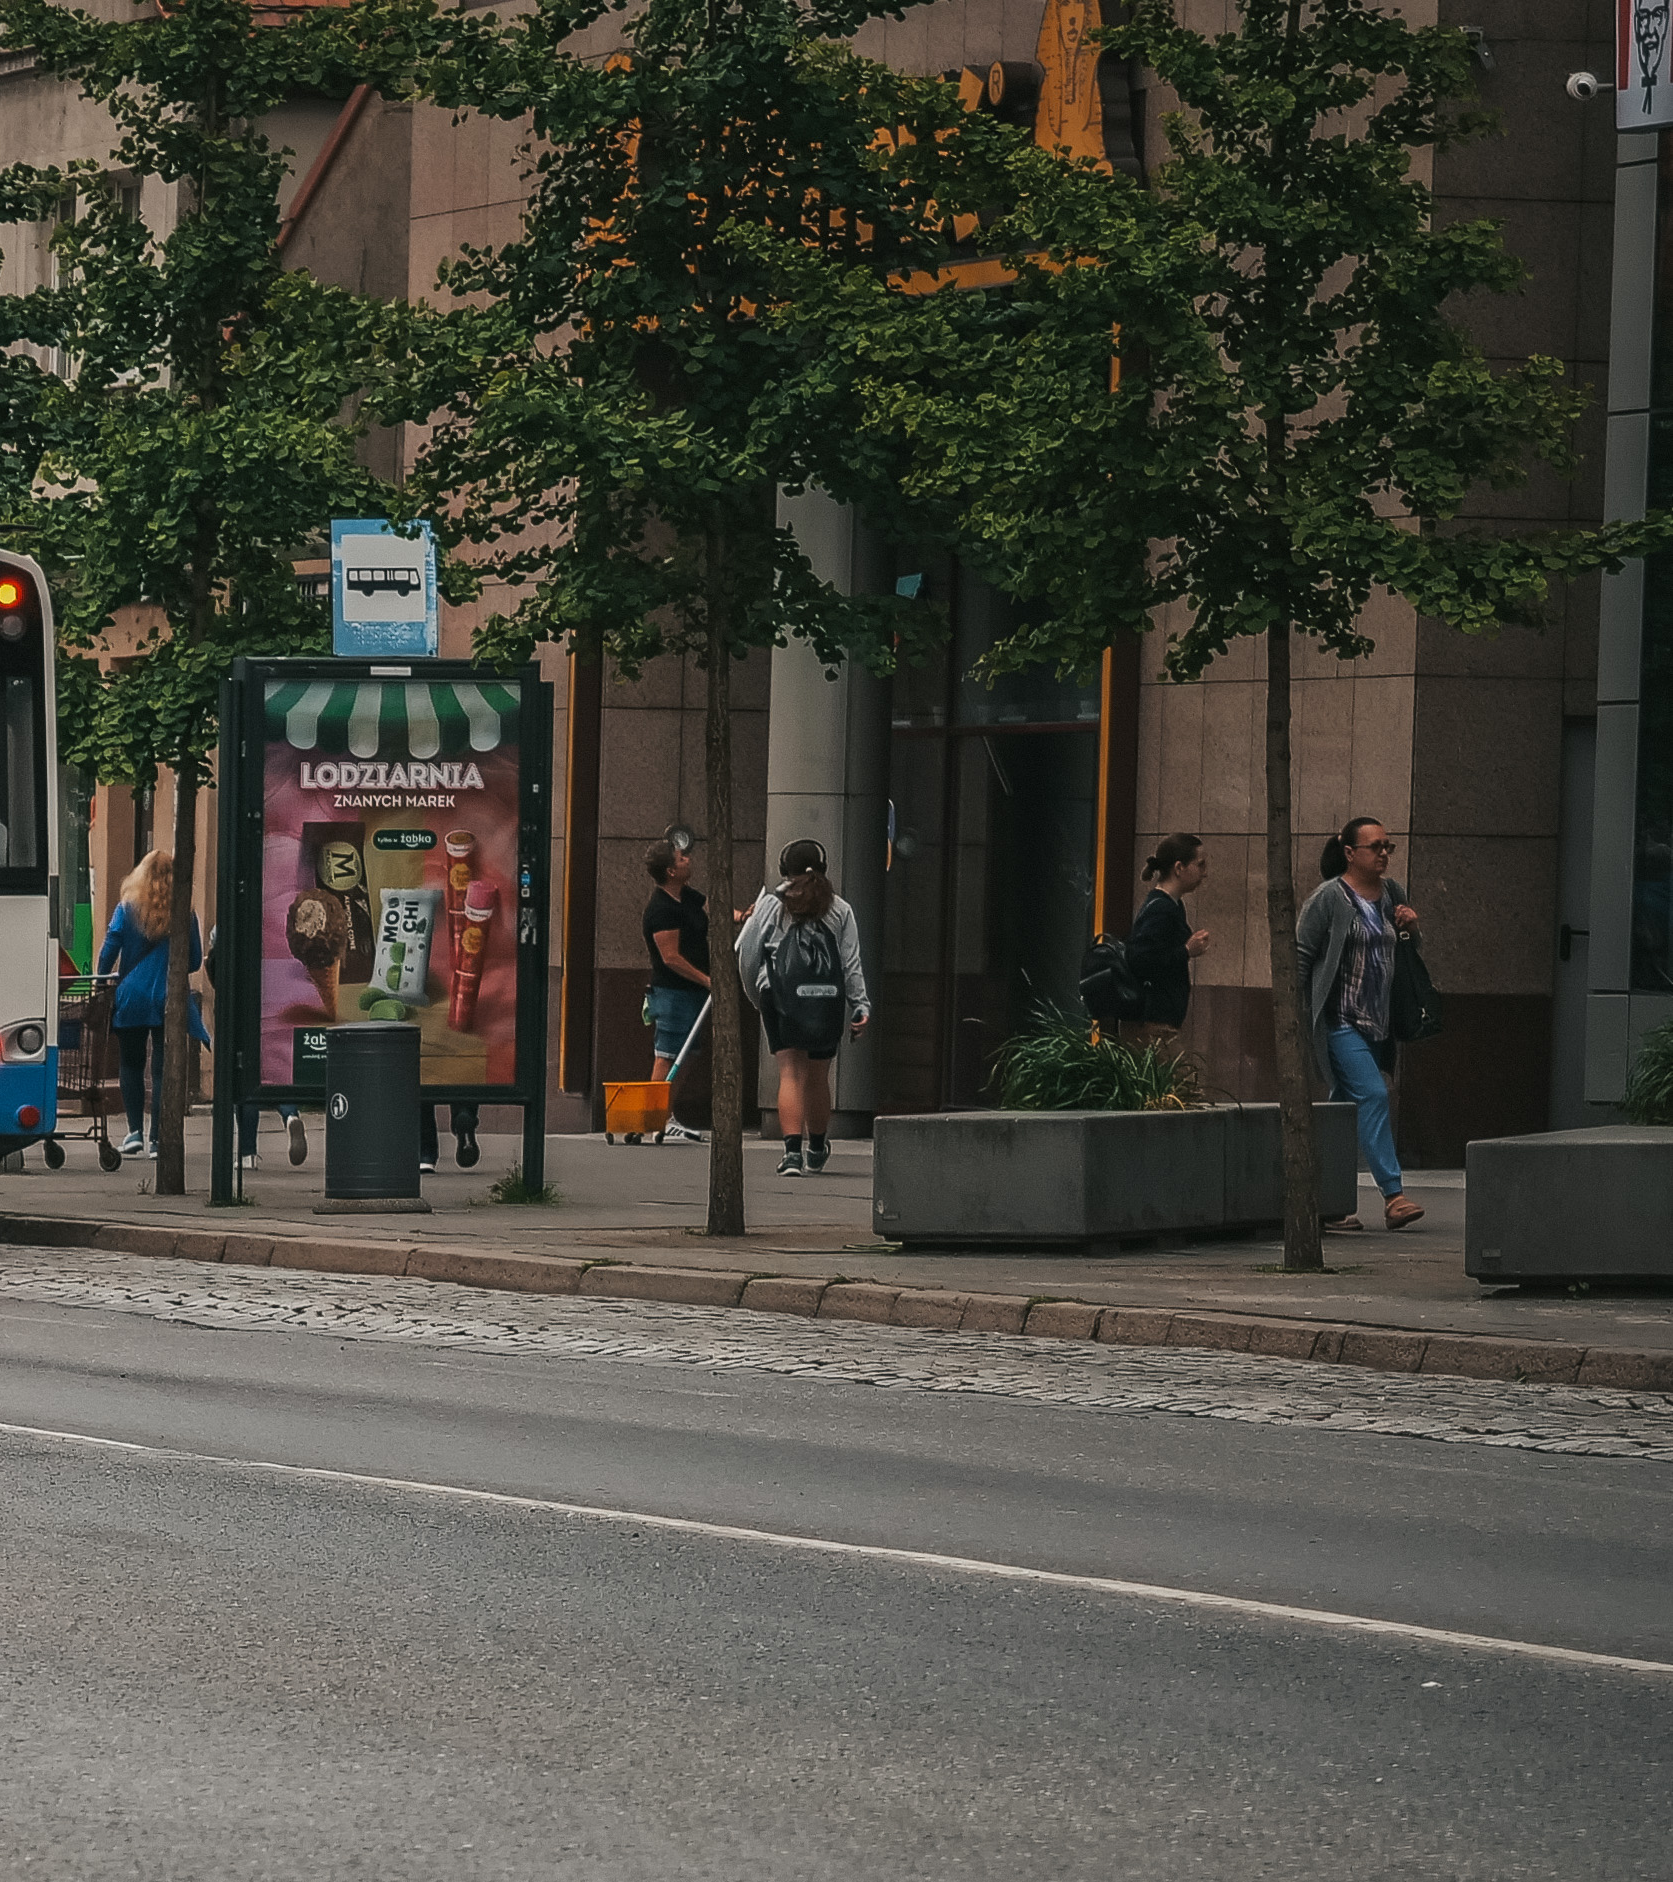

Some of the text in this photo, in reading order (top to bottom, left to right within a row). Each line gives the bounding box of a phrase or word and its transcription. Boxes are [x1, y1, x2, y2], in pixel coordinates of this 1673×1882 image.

[301, 762, 485, 790] LODZIARNIA
[334, 794, 456, 808] ZNANYCH MAREK
[400, 832, 432, 844] żabka
